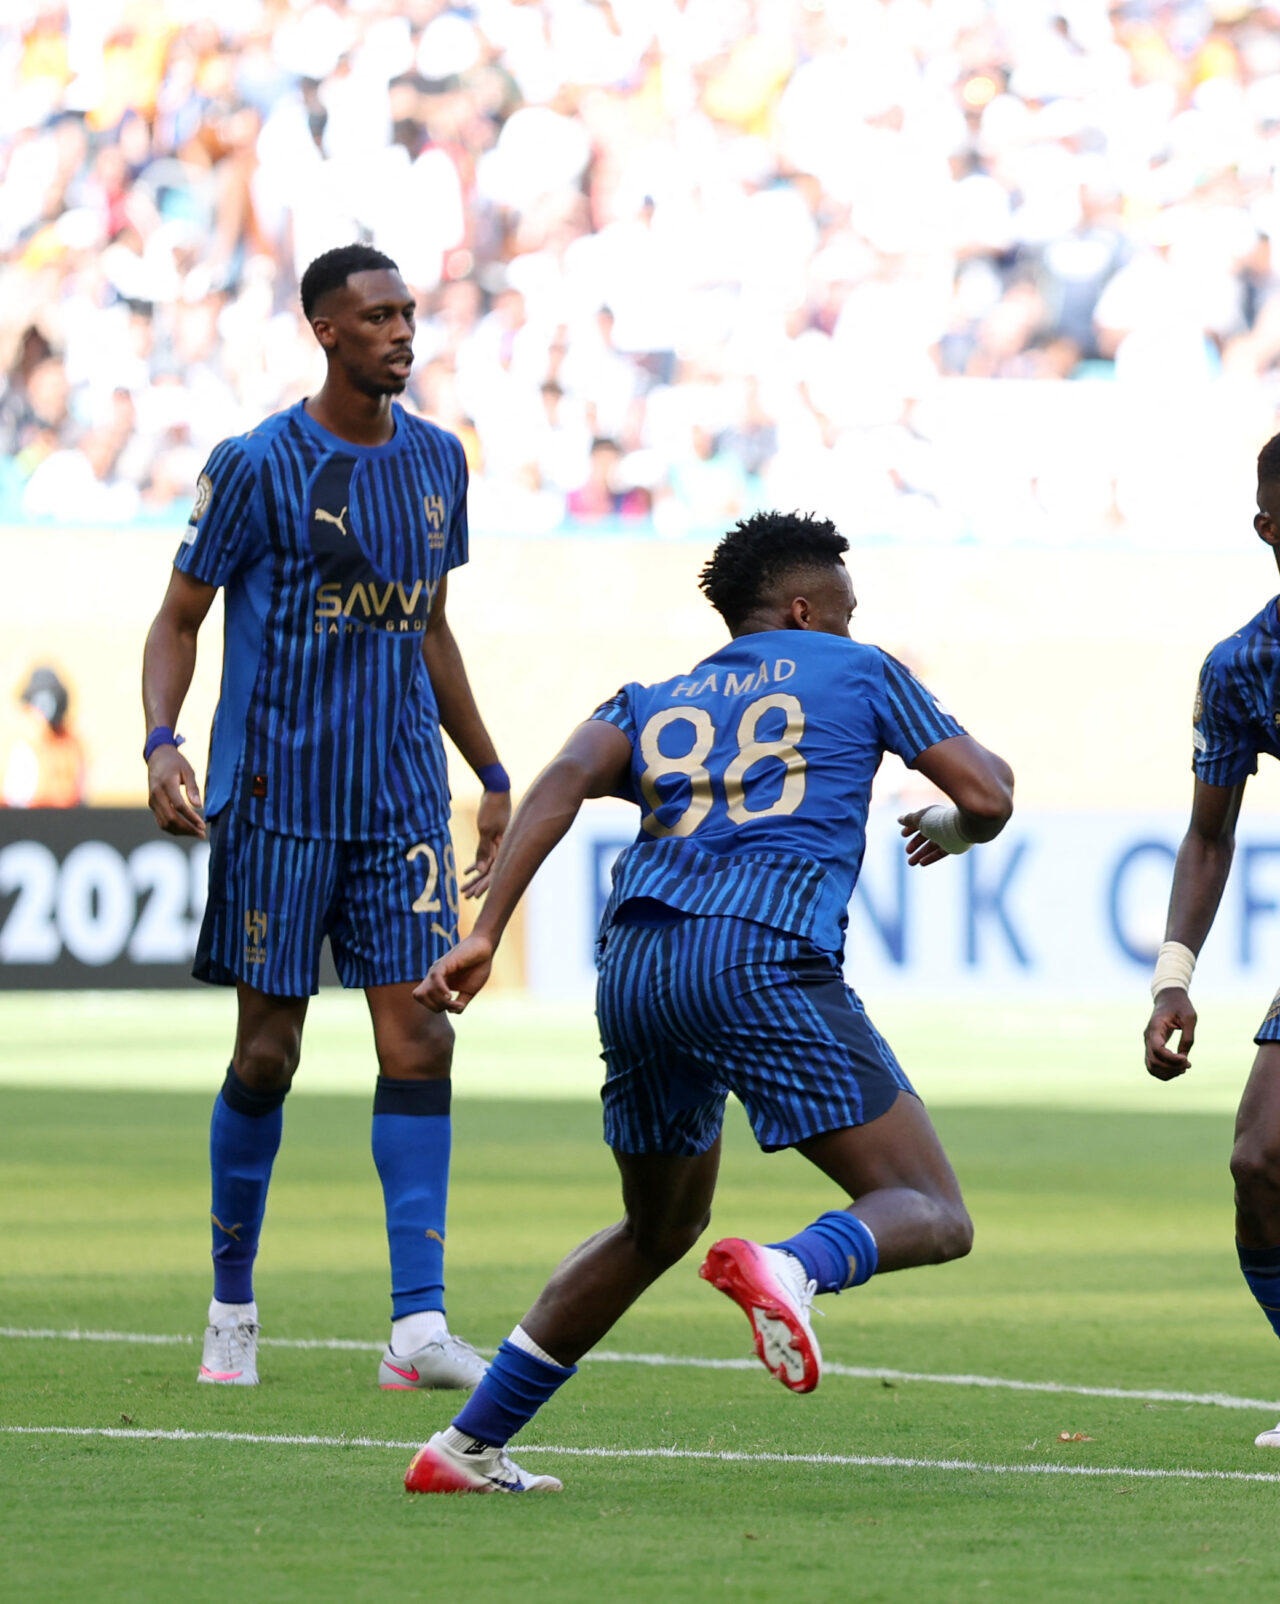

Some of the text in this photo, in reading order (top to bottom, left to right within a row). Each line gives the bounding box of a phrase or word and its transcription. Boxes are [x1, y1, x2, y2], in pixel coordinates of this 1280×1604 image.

[315, 579, 438, 617] SAVVY
[385, 619, 427, 633] GRO
[671, 658, 796, 696] HAMAD
[640, 692, 807, 838] 88
[0, 838, 209, 967] 202
